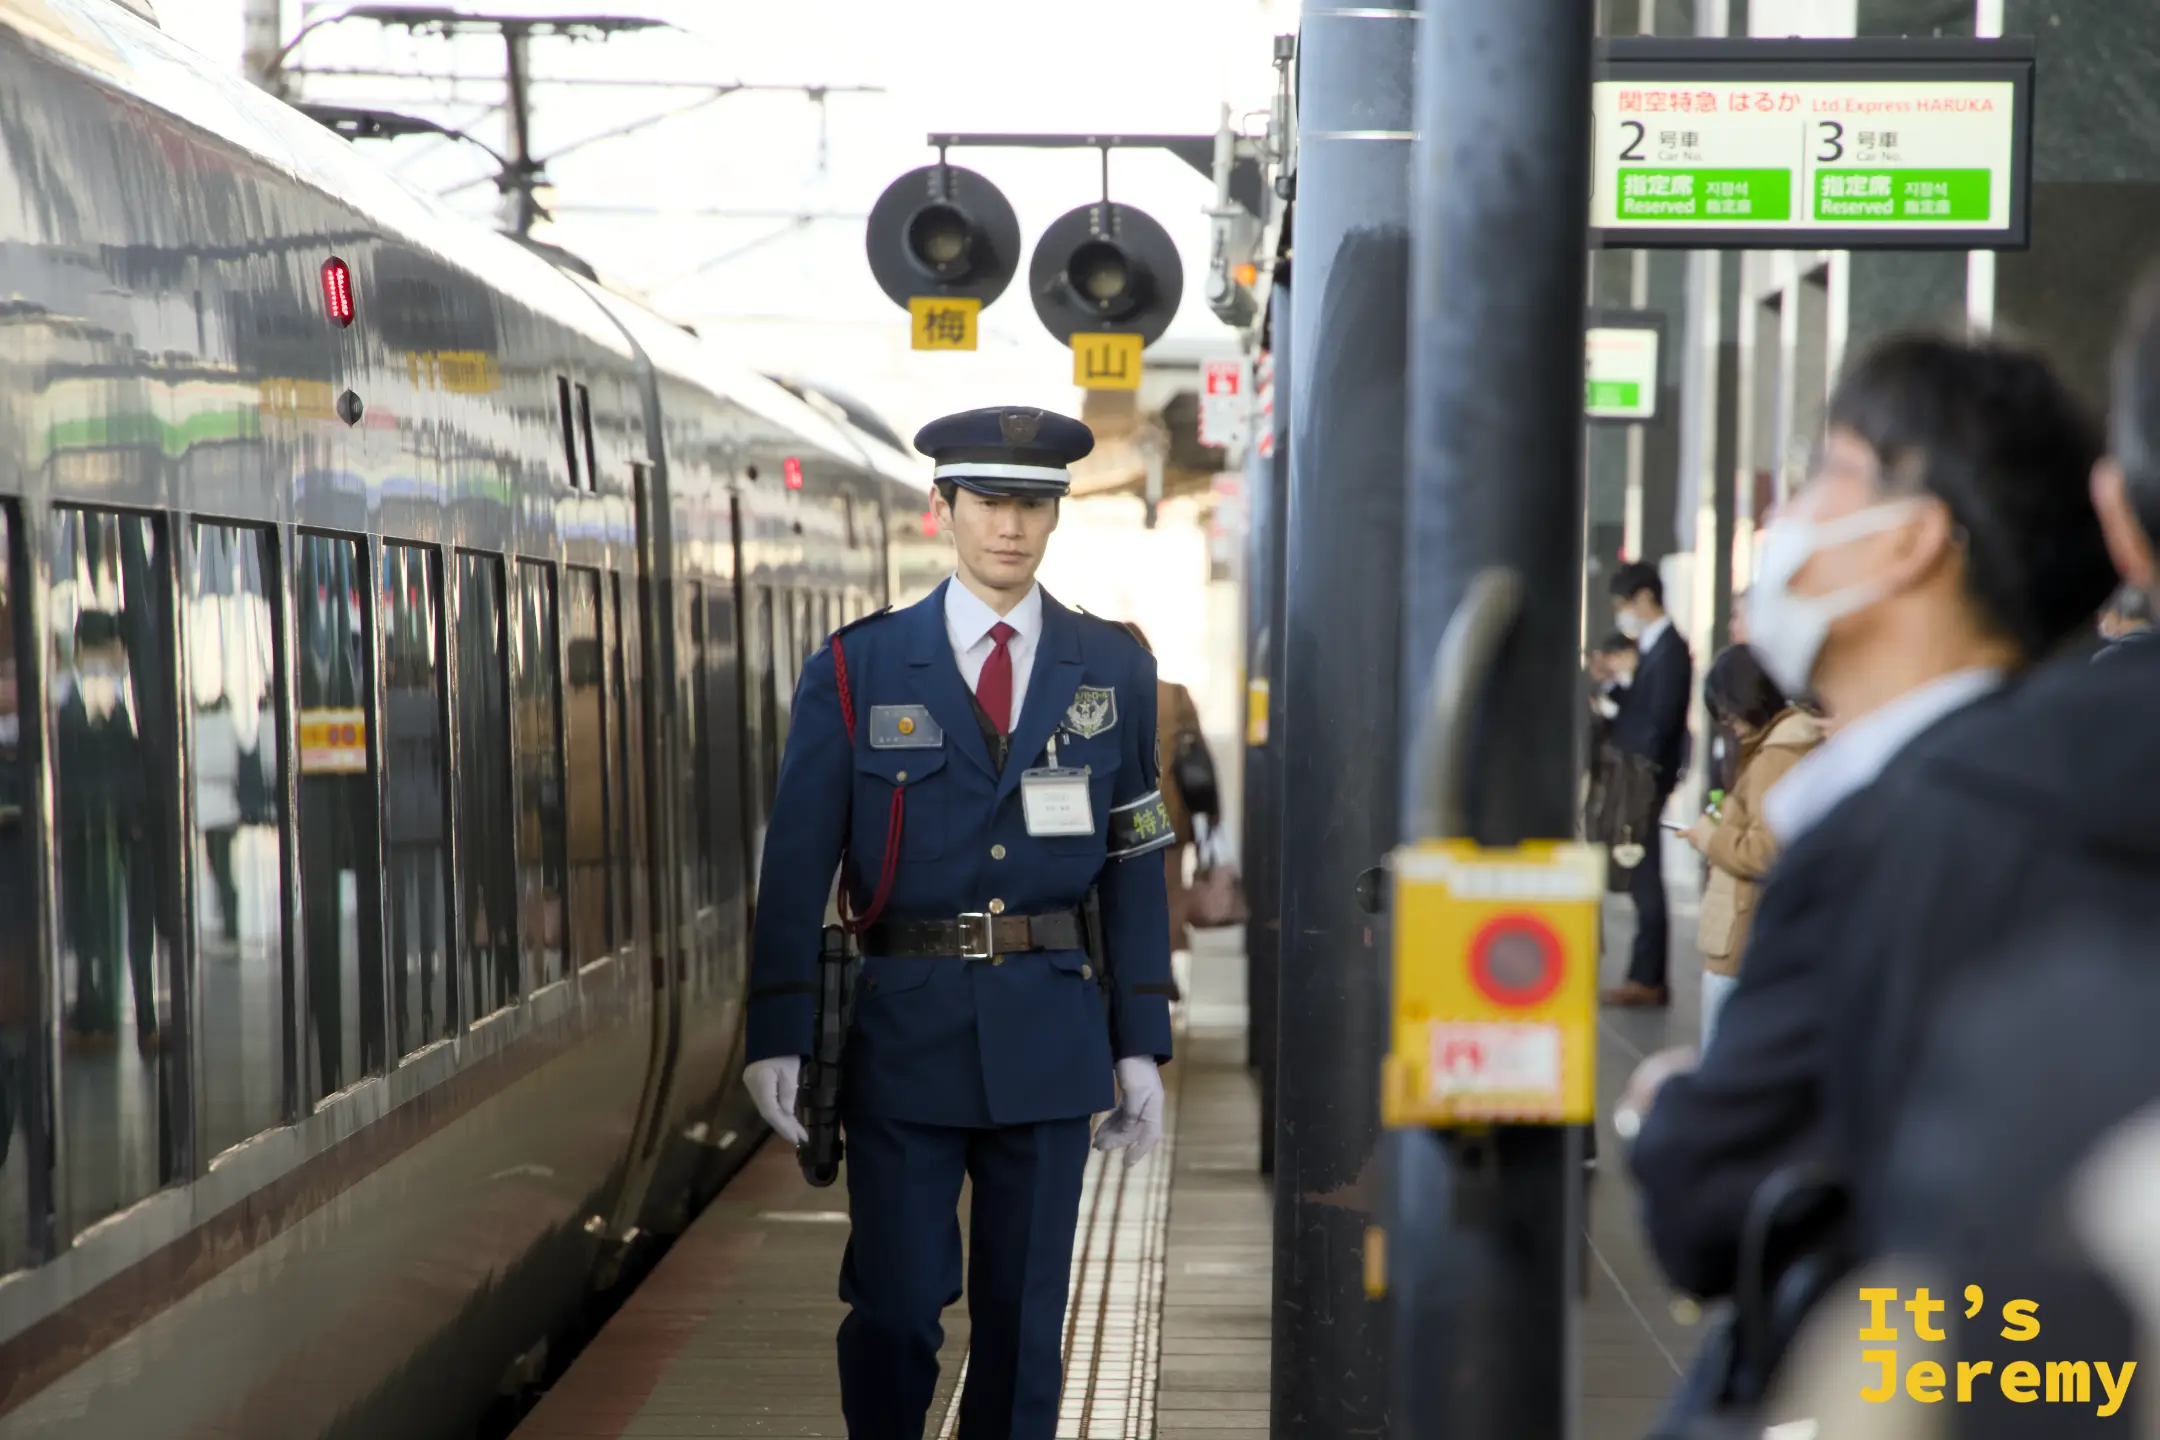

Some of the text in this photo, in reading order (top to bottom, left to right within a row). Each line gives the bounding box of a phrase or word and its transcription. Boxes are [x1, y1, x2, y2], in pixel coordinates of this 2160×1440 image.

[1618, 90, 1801, 114] 関空特急 はるか
[1916, 98, 1994, 113] HARUKA
[1619, 121, 1646, 162] 2
[1660, 131, 1698, 149] 号車
[1817, 121, 1844, 162] 3
[1858, 131, 1897, 149] 号車
[1623, 174, 1694, 197] 指定席
[1820, 174, 1891, 196] 指定席
[1623, 197, 1696, 215] Reserved
[1820, 197, 1894, 214] Reserved
[924, 308, 966, 344] 梅
[1087, 346, 1126, 379] 山
